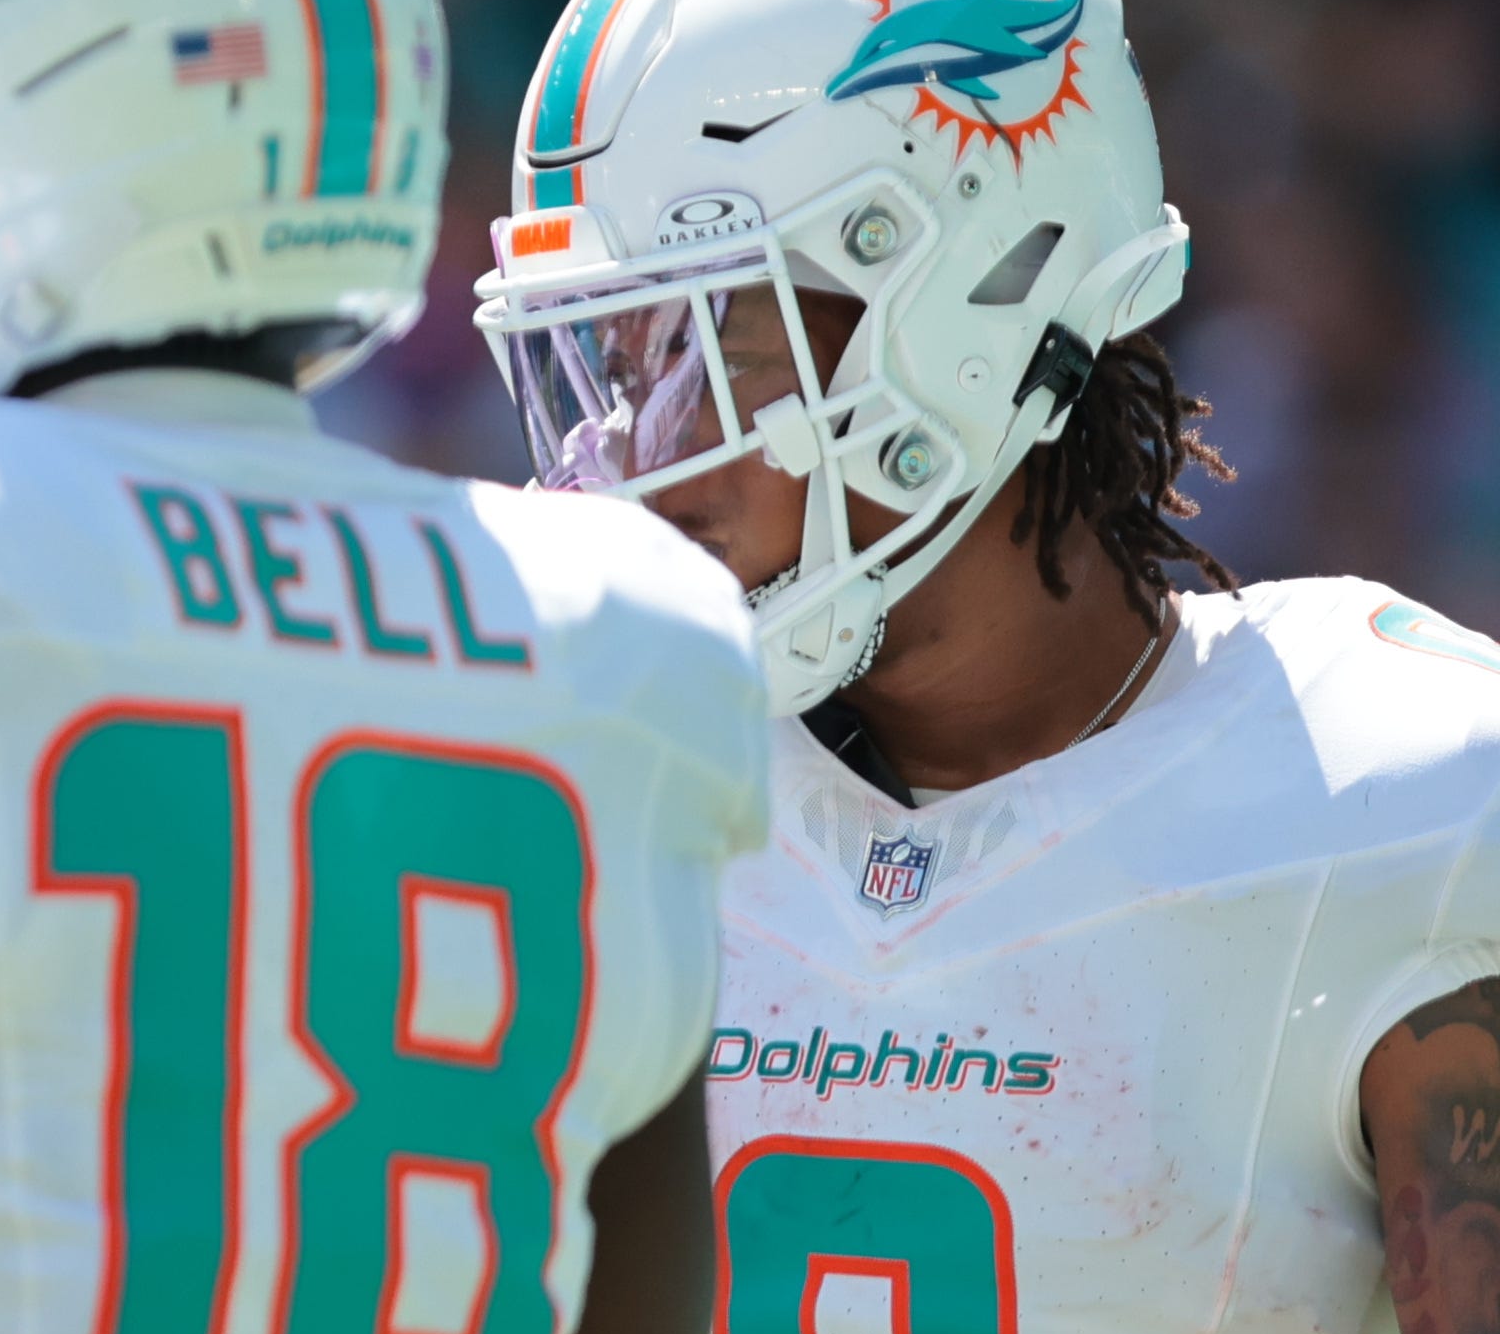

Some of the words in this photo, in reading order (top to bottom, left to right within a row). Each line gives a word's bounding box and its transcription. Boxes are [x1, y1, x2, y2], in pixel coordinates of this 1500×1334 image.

[659, 218, 756, 245] OAKLEY
[125, 478, 535, 672] BELL
[867, 870, 917, 901] NFL
[706, 1026, 1060, 1101] Dolphins
